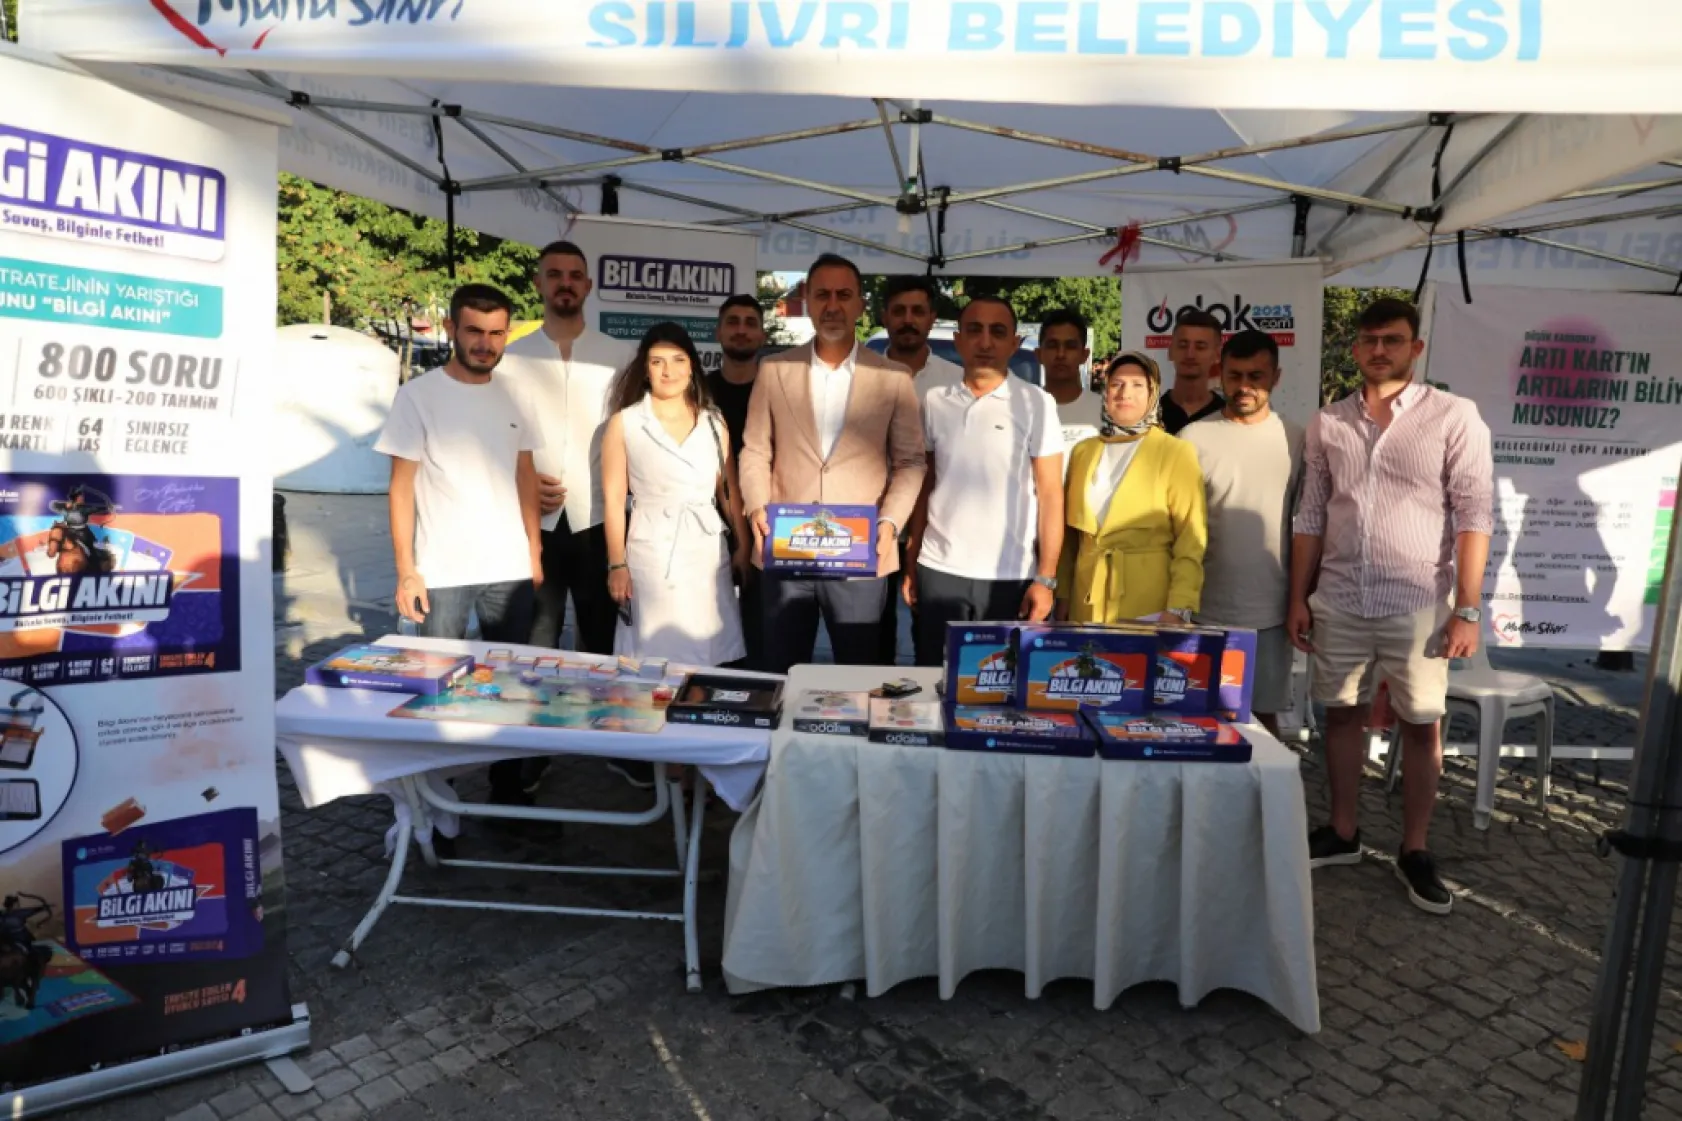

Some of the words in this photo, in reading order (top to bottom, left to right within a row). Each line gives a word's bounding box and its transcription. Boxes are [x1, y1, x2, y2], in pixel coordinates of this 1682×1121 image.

[56, 148, 218, 232] AKINI
[57, 217, 111, 240] Bilginle
[116, 229, 164, 248] Fethet!
[668, 264, 732, 293] AKINI
[116, 283, 199, 308] YARIŞTIĞI
[1252, 304, 1292, 317] 2023
[38, 341, 117, 381] 800
[125, 349, 223, 389] SORU
[1519, 346, 1567, 370] ARTI
[1571, 350, 1651, 374] KART'IN
[34, 385, 68, 401] 600
[1516, 374, 1629, 402] ARTILARINI
[78, 417, 104, 436] 64
[1512, 403, 1621, 429] MUSUNUZ?
[72, 574, 169, 608] AKINI
[1085, 679, 1123, 694] AKINI
[143, 888, 194, 913] AKINI
[231, 978, 246, 1004] 4
